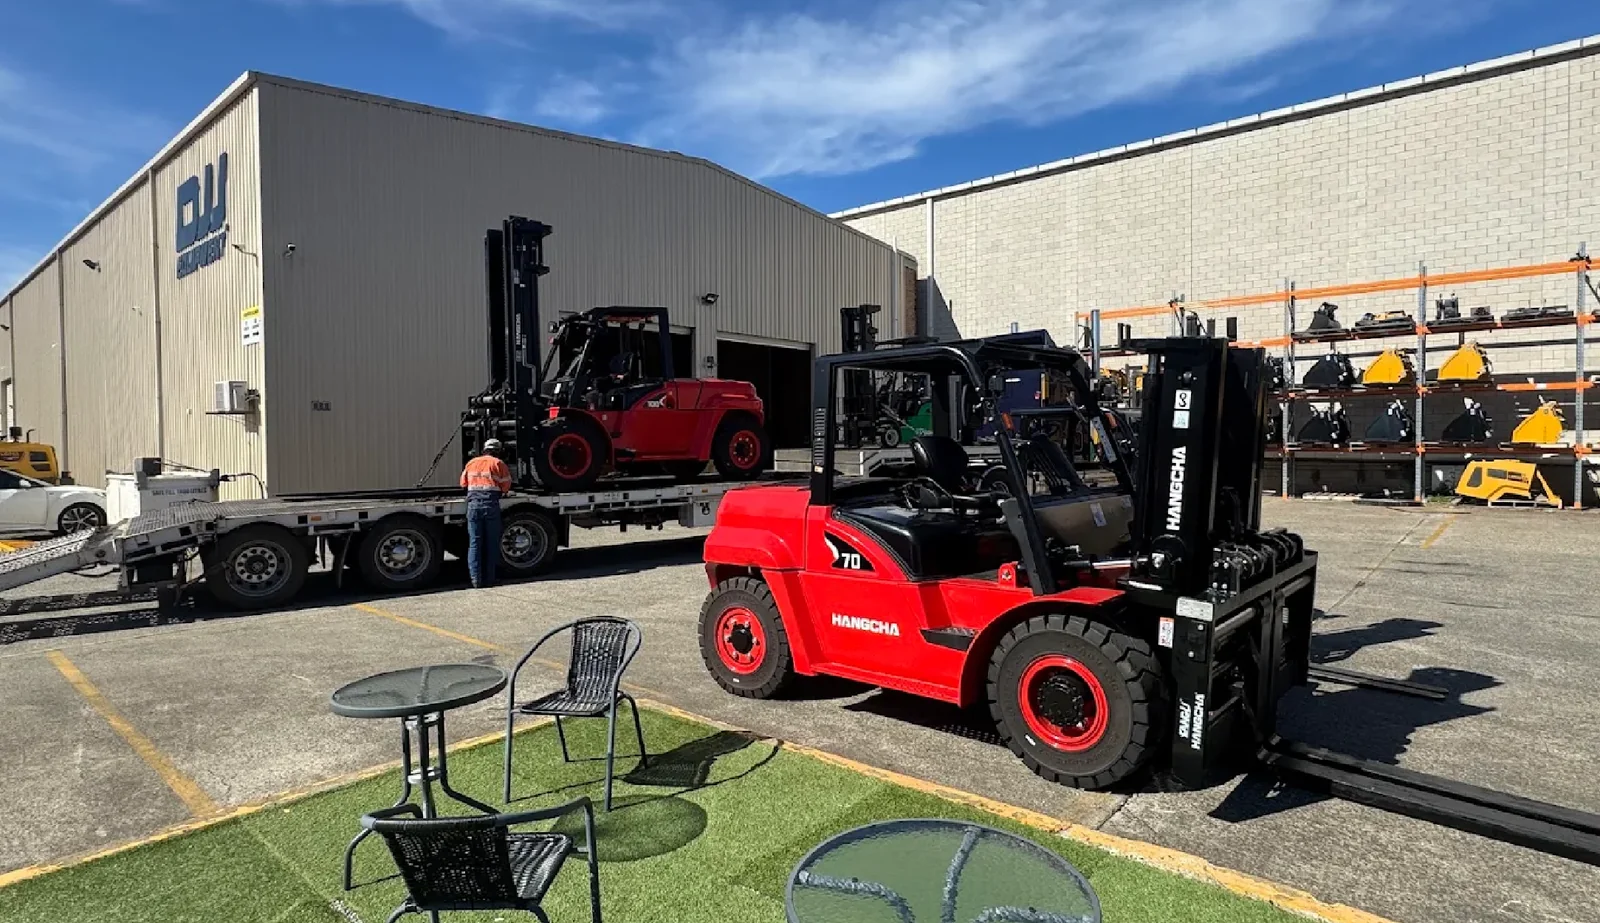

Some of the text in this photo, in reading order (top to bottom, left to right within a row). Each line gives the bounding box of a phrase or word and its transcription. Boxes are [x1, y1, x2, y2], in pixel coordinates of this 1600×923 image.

[1166, 446, 1186, 530] HANGCHA
[842, 553, 860, 569] 70
[832, 612, 900, 636] HANGCHA
[1191, 693, 1205, 750] HANGCHA
